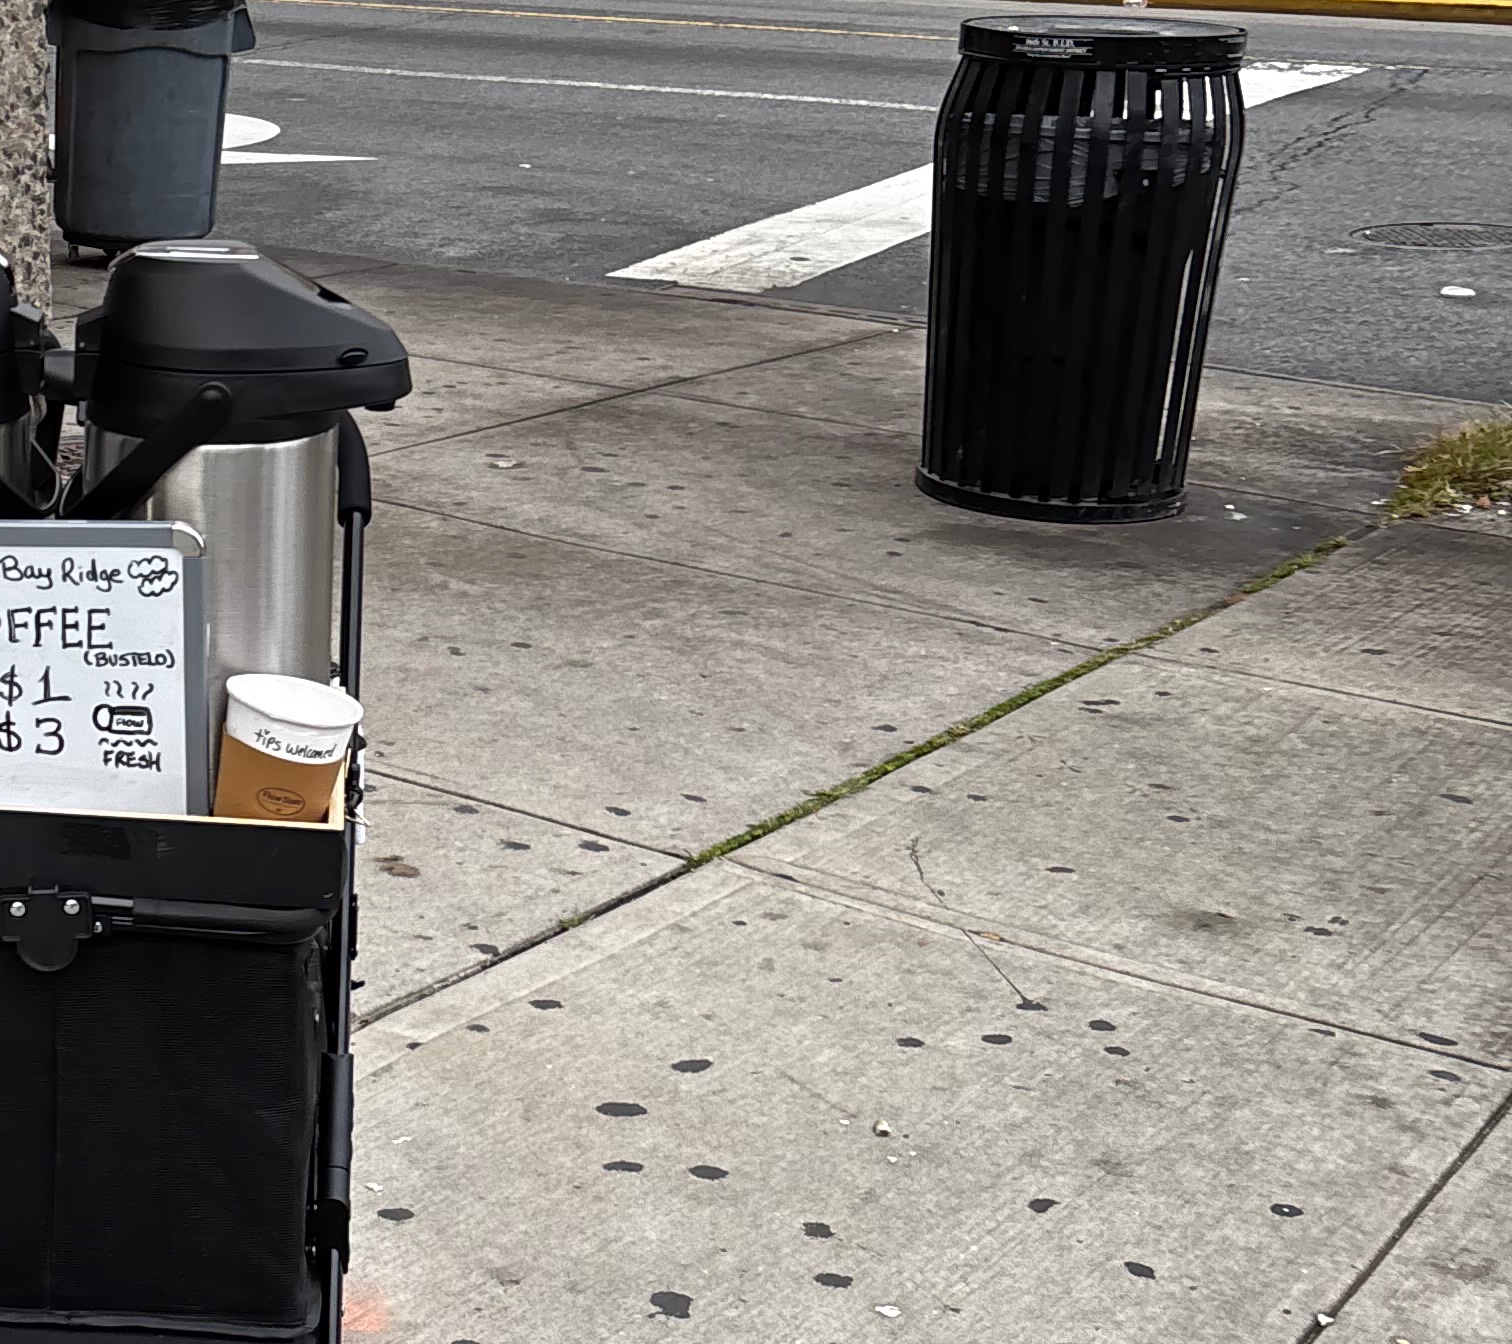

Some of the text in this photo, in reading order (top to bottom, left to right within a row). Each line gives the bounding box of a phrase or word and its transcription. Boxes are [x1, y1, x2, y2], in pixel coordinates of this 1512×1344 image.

[61, 557, 124, 592] Ridge
[83, 649, 176, 668] (BUSTELO)
[103, 750, 162, 773] FRESH
